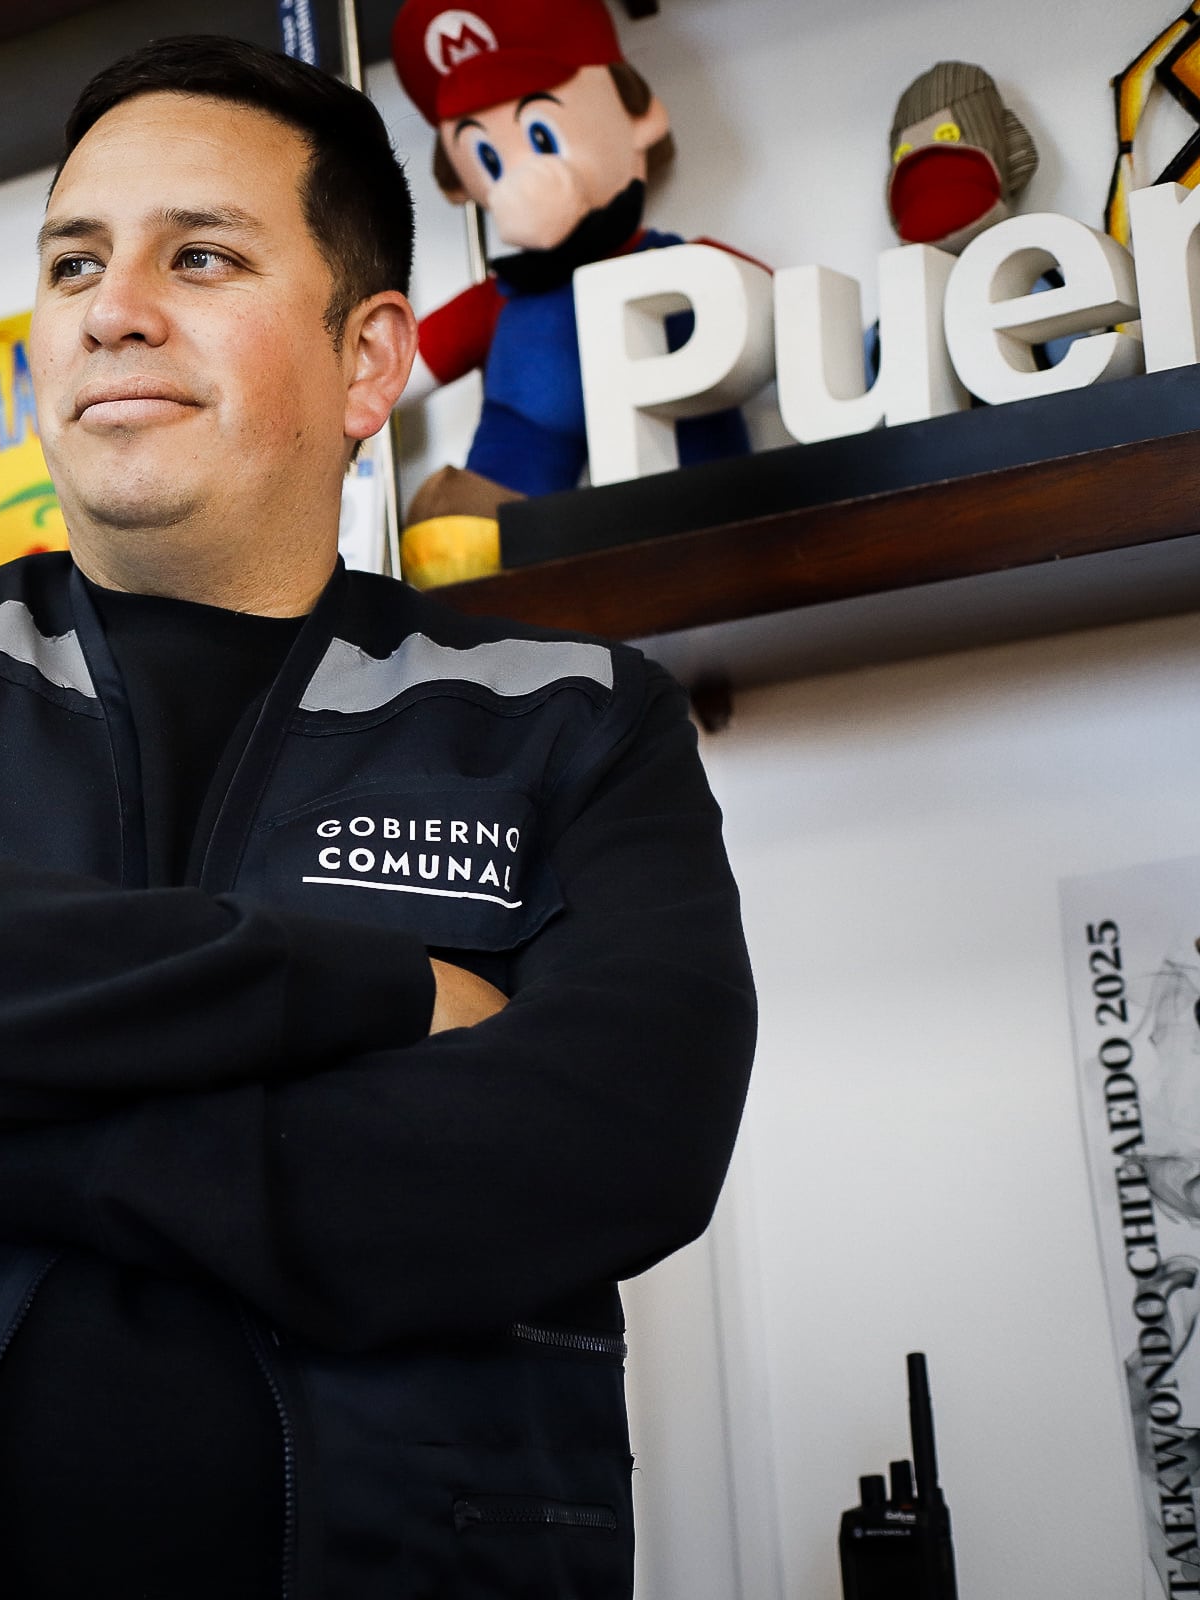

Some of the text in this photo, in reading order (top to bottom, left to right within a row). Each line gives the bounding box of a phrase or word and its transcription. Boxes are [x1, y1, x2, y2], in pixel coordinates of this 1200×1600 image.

[438, 21, 488, 70] M
[573, 180, 1200, 488] Puer
[316, 816, 520, 853] GOBIERNO
[318, 847, 511, 892] COMUNAL
[1086, 919, 1128, 1027] 2025
[1132, 1291, 1200, 1600] TAEKWONDO
